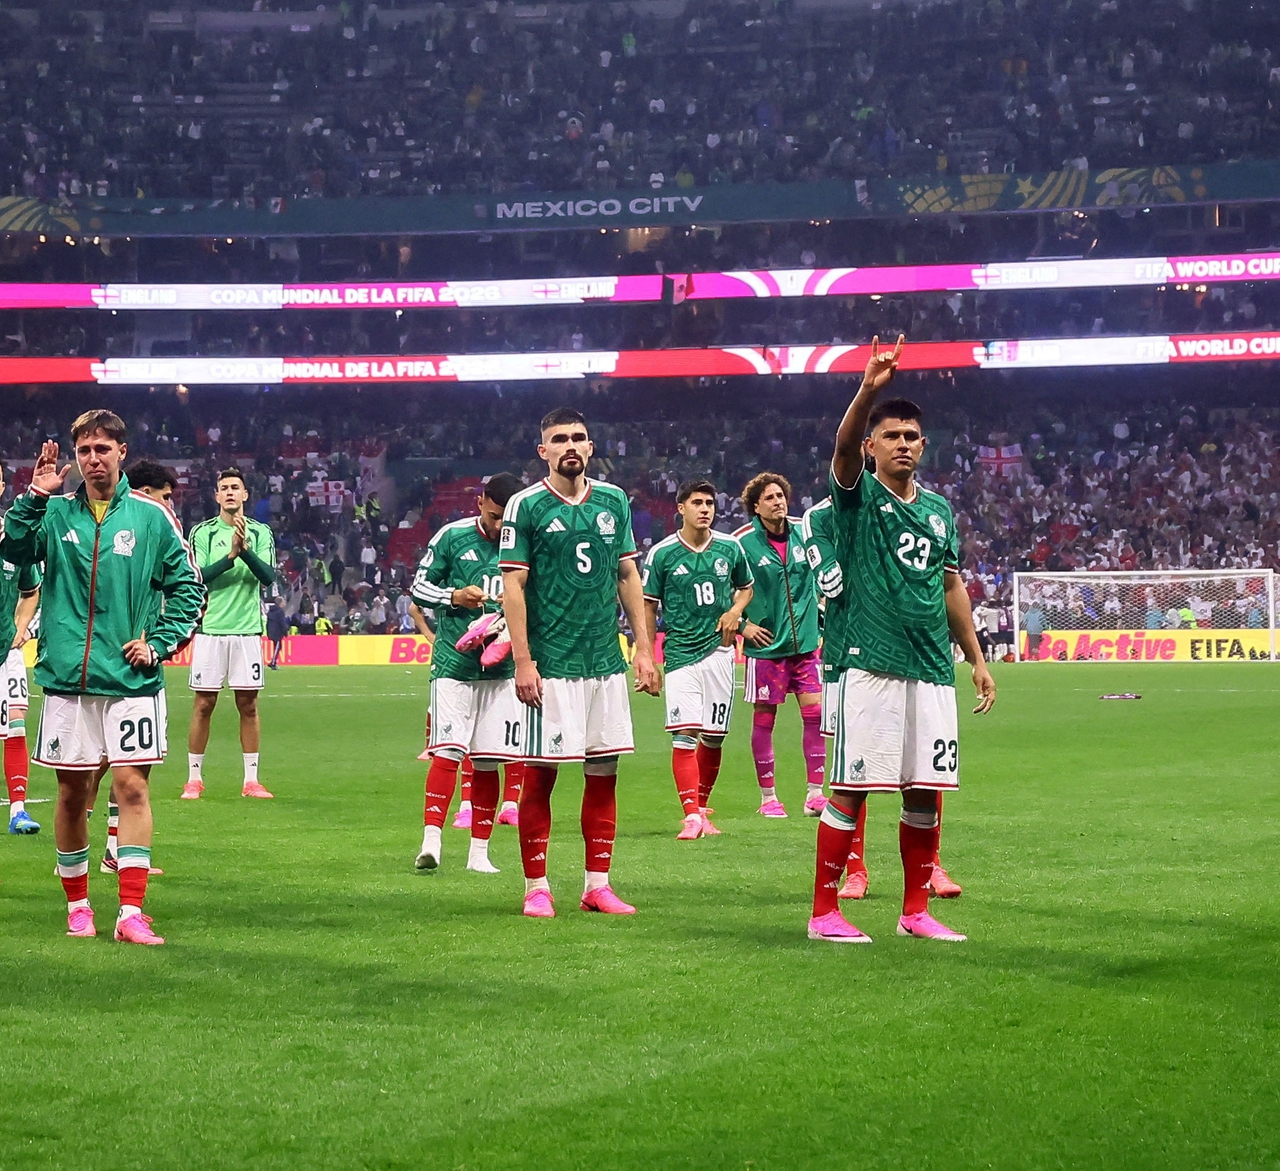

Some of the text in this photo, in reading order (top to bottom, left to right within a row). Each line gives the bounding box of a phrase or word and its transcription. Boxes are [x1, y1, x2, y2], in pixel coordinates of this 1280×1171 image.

[496, 195, 704, 219] MEXICO CITY
[1001, 266, 1058, 283] ENGLAND
[1135, 262, 1175, 279] FIFA
[1176, 259, 1246, 278] WORLD
[120, 288, 177, 305] ENGLAND
[210, 285, 501, 305] COPA MUNDIAL DE LA FIFA 2026
[560, 281, 616, 298] ENGLAND
[1136, 341, 1177, 358] FIFA
[1178, 338, 1248, 357] WORLD
[210, 362, 260, 378] COPA
[262, 362, 343, 379] MUNDIAL
[344, 362, 370, 378] DE
[371, 361, 396, 377] LA
[396, 360, 437, 377] FIFA
[575, 542, 592, 574] 5
[897, 532, 931, 570] 23
[482, 574, 504, 601] 10
[693, 581, 715, 607] 18
[389, 637, 431, 664] Be
[1025, 631, 1246, 661] Be Active FIFA
[252, 663, 261, 681] 3
[8, 677, 28, 698] 26
[0, 700, 9, 726] 8
[711, 702, 727, 725] 18
[120, 717, 153, 750] 20
[504, 720, 521, 746] 10
[932, 738, 958, 772] 23
